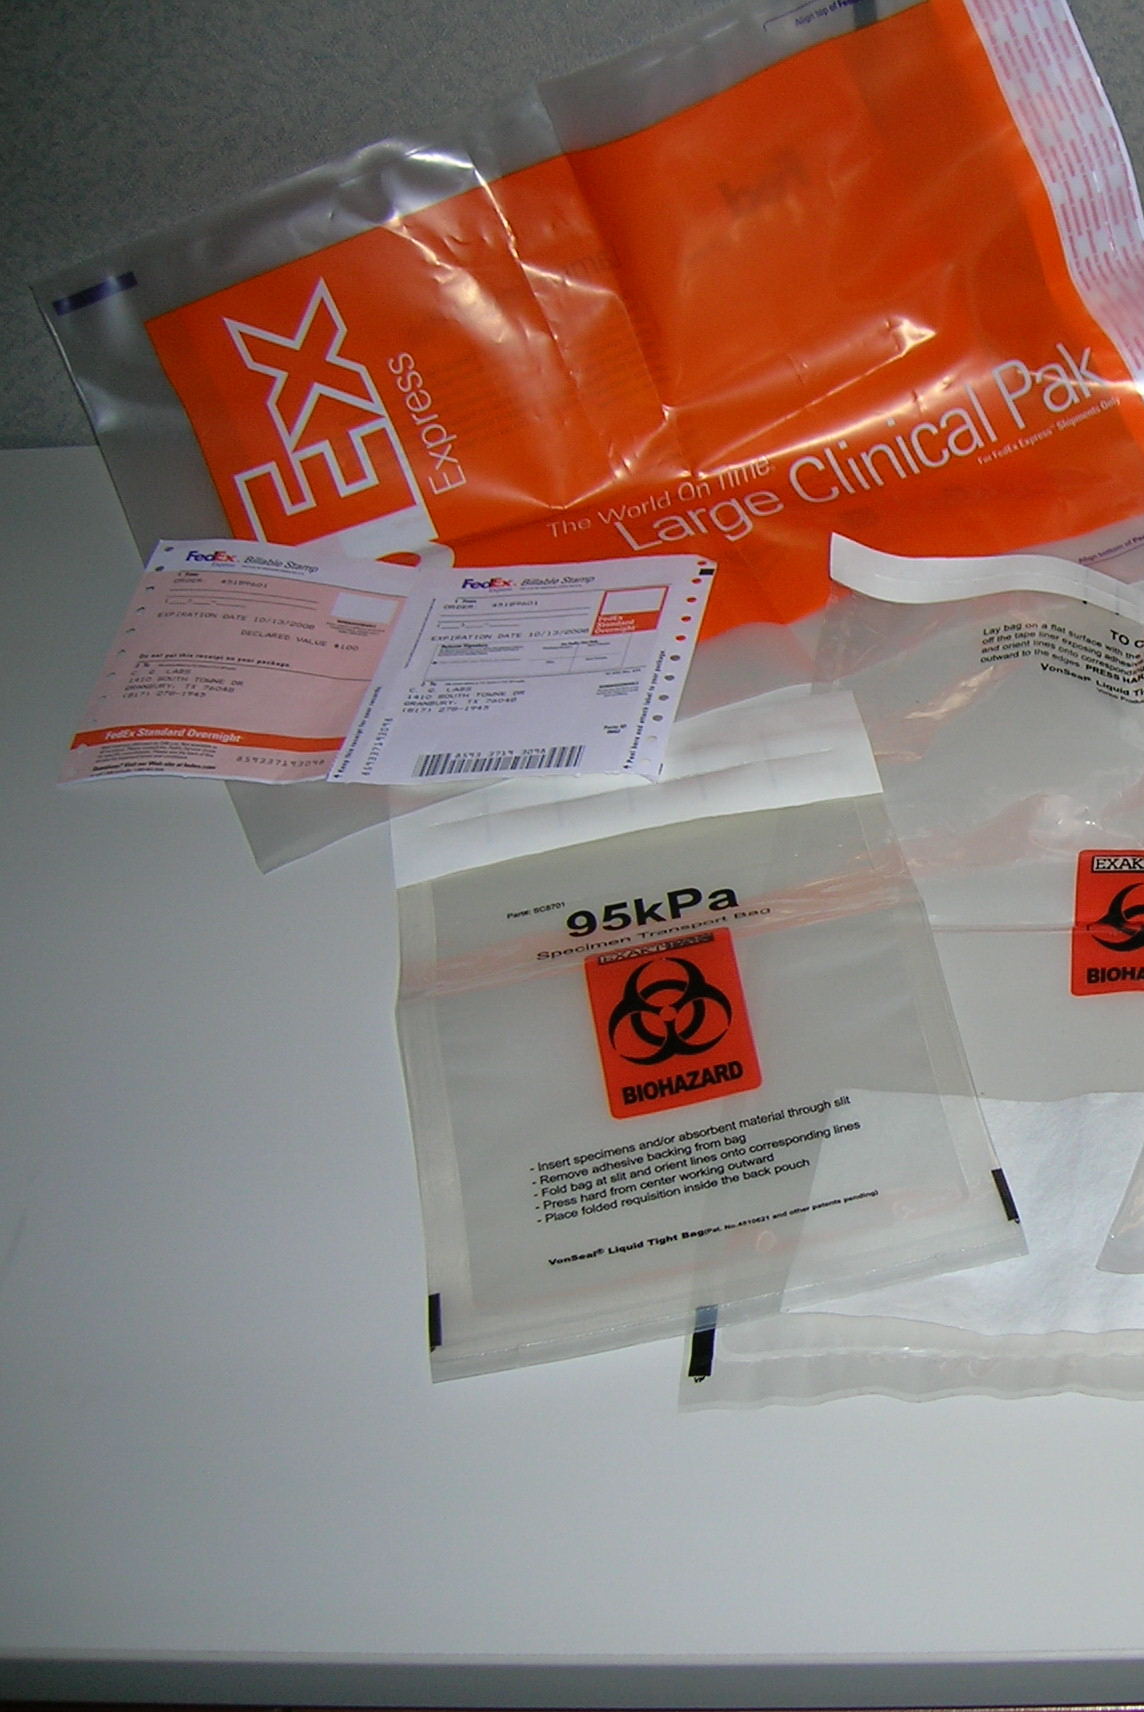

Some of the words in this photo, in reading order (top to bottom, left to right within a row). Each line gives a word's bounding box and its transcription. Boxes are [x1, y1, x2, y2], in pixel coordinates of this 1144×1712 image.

[389, 352, 467, 495] Express
[614, 490, 785, 550] Large
[789, 384, 997, 503] Clinical
[992, 343, 1110, 430] Pak
[547, 518, 592, 538] The
[597, 491, 672, 525] World
[677, 481, 711, 500] On
[718, 456, 772, 491] Time
[185, 550, 238, 562] FedEx
[284, 560, 320, 574] Stamp
[461, 577, 513, 589] FedEx
[981, 646, 1000, 654] and
[1002, 640, 1031, 650] orient
[1033, 640, 1056, 650] lines
[1058, 646, 1079, 658] onto
[982, 636, 995, 645] off
[996, 634, 1012, 642] the
[1014, 631, 1036, 639] tape
[1038, 631, 1059, 640] liner
[1061, 637, 1102, 658] exposing
[983, 627, 1000, 636] Lay
[1003, 622, 1022, 631] bag
[1050, 623, 1066, 634] flat
[1068, 630, 1103, 648] surface
[1105, 644, 1123, 656] with
[1125, 650, 1141, 659] the
[1109, 629, 1130, 646] TO
[980, 651, 1019, 663] outward
[1034, 649, 1050, 657] the
[1085, 664, 1120, 681] PRESS
[1096, 680, 1130, 696] Liquid
[537, 936, 632, 962] Specimen
[637, 915, 728, 939] Transport
[734, 907, 772, 920] Bag
[566, 887, 739, 938] 95kPa
[622, 1060, 744, 1105] BIOHAZARD
[538, 1157, 571, 1172] Insert
[573, 1144, 636, 1165] specimens
[639, 1135, 676, 1150] and/or
[678, 1121, 738, 1143] absorbent
[739, 1110, 786, 1129] material
[787, 1099, 832, 1118] through
[834, 1095, 851, 1107] slit
[540, 1168, 589, 1186] Remove
[592, 1157, 645, 1175] adhesive
[647, 1144, 693, 1162] backing
[695, 1139, 722, 1152] from
[724, 1133, 747, 1147] bag
[542, 1184, 568, 1198] Fold
[571, 1180, 593, 1194] bag
[596, 1177, 608, 1187] at
[610, 1173, 627, 1184] slit
[630, 1167, 652, 1180] and
[654, 1157, 689, 1174] orient
[690, 1153, 718, 1166] lines
[720, 1148, 746, 1160] onto
[749, 1126, 832, 1154] corresponding
[833, 1121, 861, 1136] lines
[543, 1196, 578, 1211] Press
[580, 1189, 607, 1204] hard
[610, 1183, 638, 1197] from
[640, 1173, 677, 1190] center
[679, 1163, 725, 1182] working
[727, 1153, 775, 1172] outward
[545, 1209, 579, 1224] Place
[581, 1199, 619, 1216] folded
[621, 1186, 682, 1208] requisition
[684, 1178, 719, 1194] inside
[721, 1173, 741, 1186] the
[742, 1165, 772, 1181] back
[774, 1158, 811, 1176] pouch
[608, 1240, 645, 1256] Liquid
[647, 1234, 679, 1247] Tight
[773, 1210, 788, 1220] and
[789, 1206, 810, 1216] other
[812, 1198, 842, 1211] patents
[844, 1189, 879, 1203] pending)
